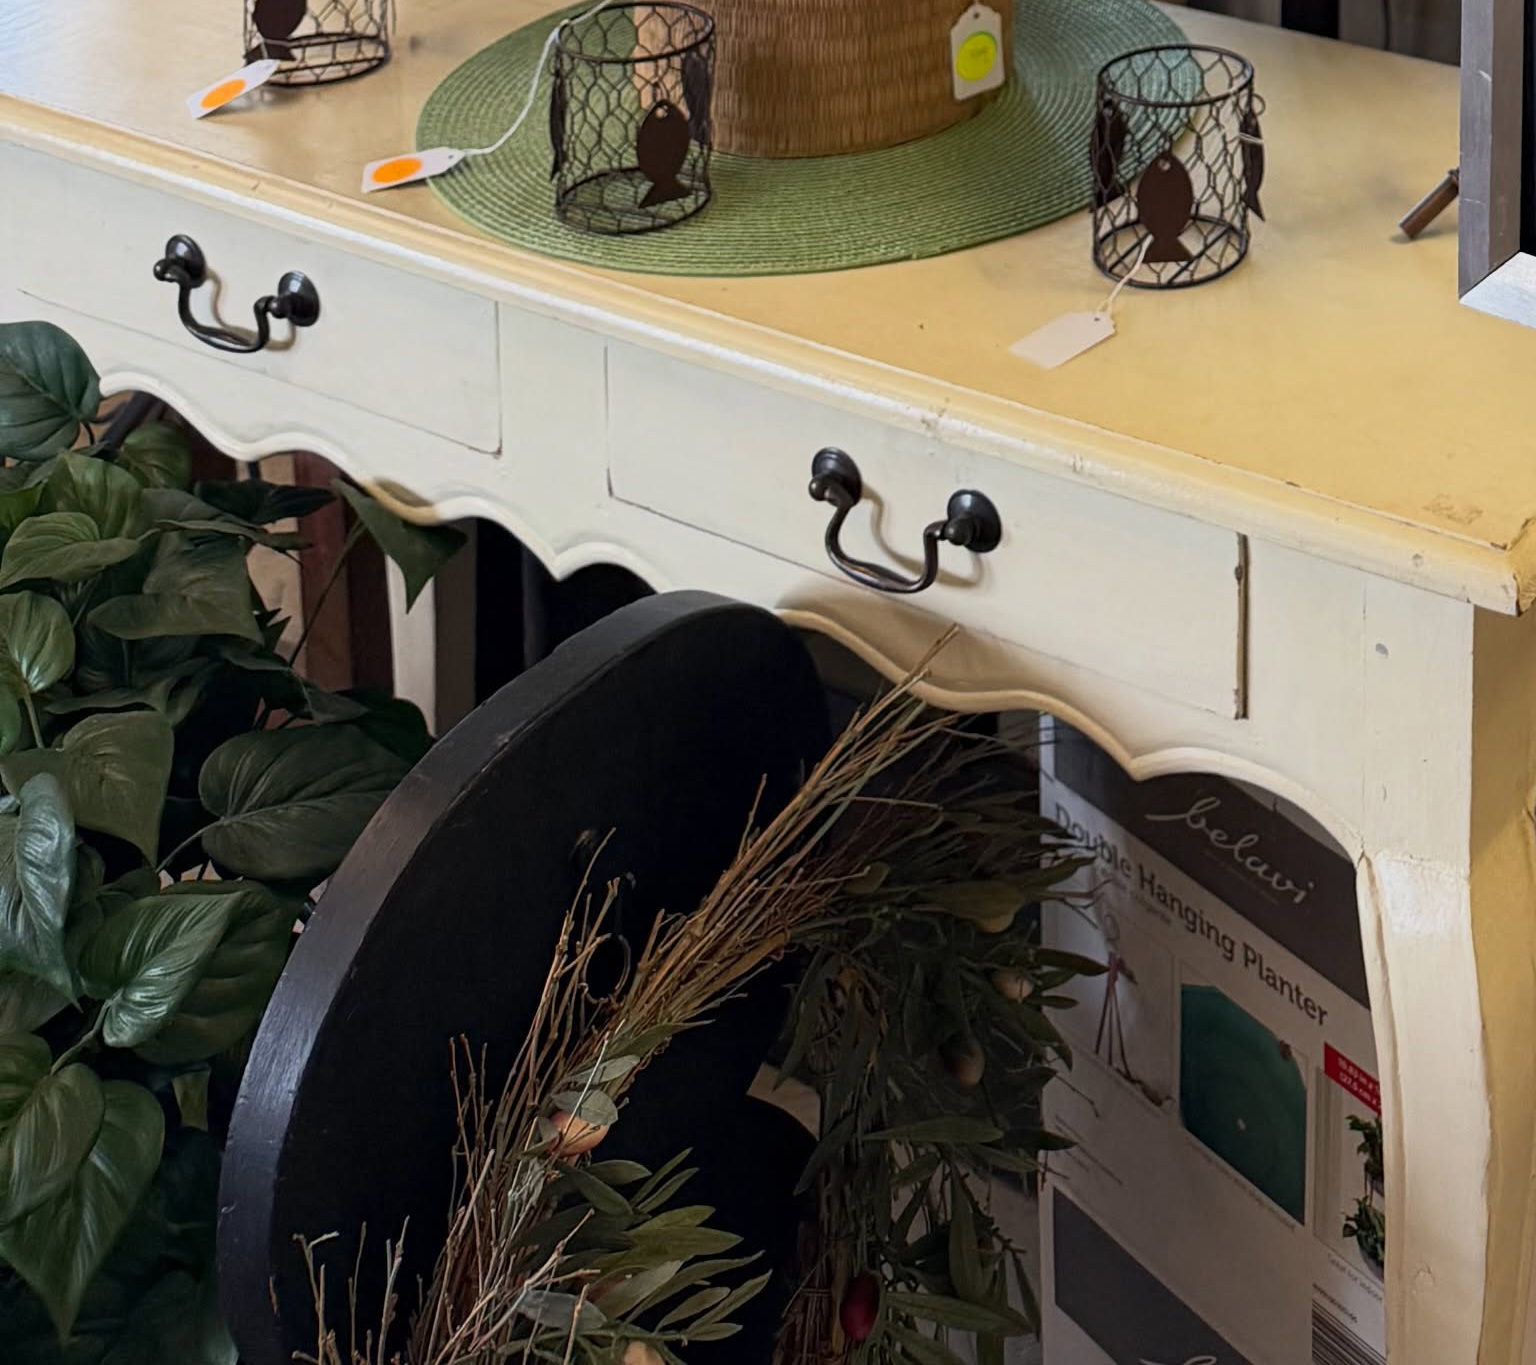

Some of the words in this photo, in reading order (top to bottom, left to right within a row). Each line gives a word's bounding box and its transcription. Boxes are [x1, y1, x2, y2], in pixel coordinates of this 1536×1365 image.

[1145, 796, 1315, 905] belavi
[1138, 863, 1238, 962] Hanging
[1243, 943, 1328, 1026] Planter
